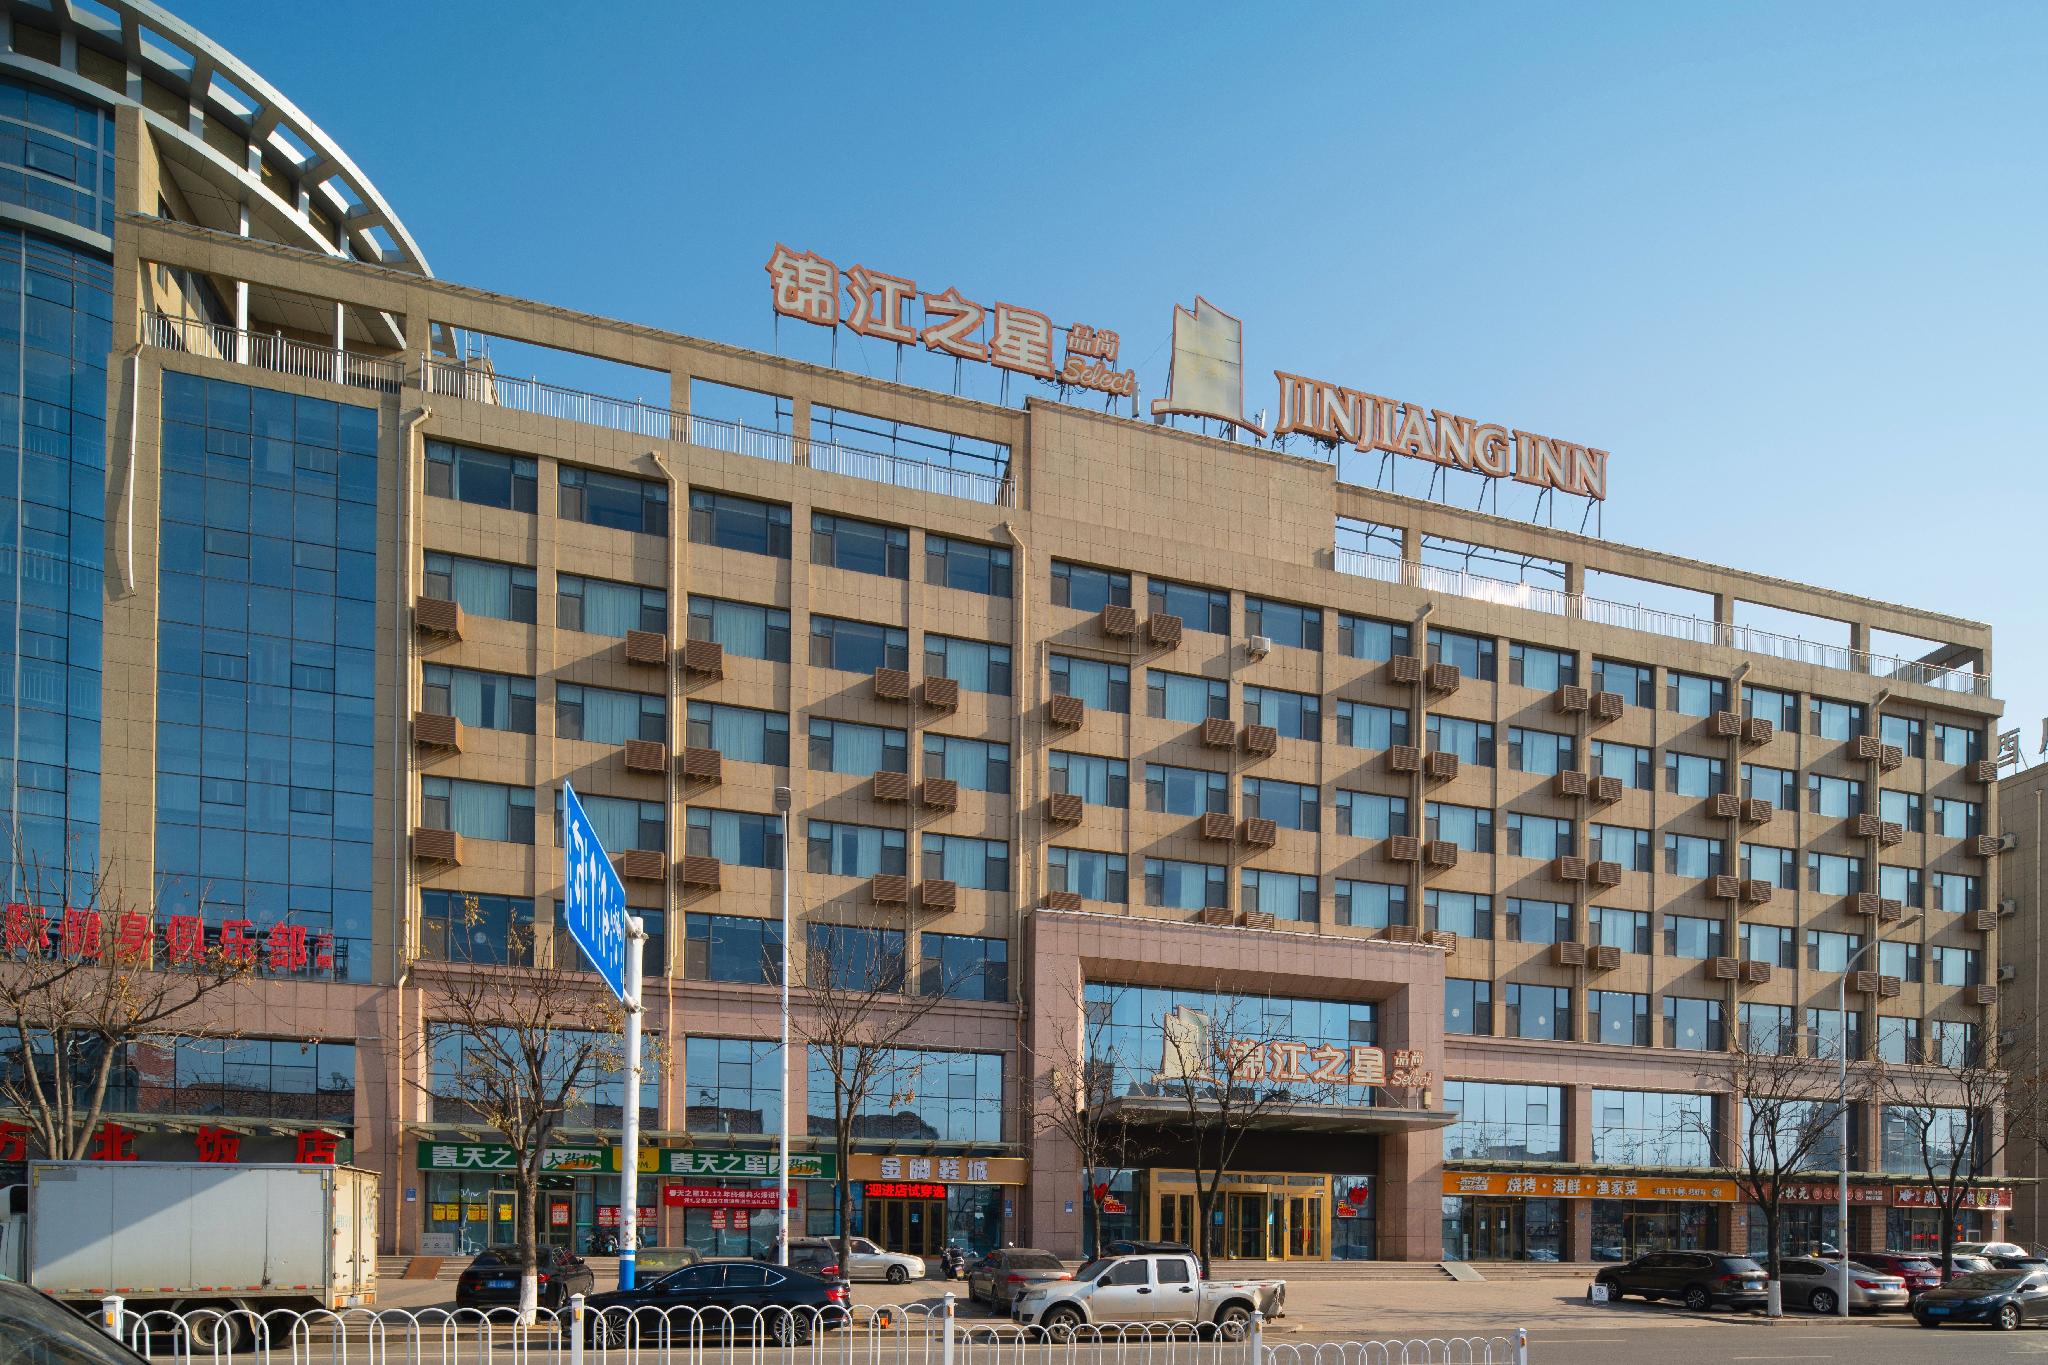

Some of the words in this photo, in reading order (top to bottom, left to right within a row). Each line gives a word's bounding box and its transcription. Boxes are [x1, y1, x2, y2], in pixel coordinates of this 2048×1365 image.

[765, 242, 1055, 380] 锦江之星
[1067, 323, 1120, 361] 品尚
[1062, 357, 1135, 397] Select
[1273, 370, 1511, 479] JINJIANG
[1513, 429, 1610, 501] INN
[1226, 1038, 1386, 1087] 锦江之星
[1390, 1068, 1433, 1088] Select
[670, 1153, 767, 1175] 春天之星
[865, 1183, 946, 1198] 迎进店试穿选
[1774, 1186, 1810, 1201] 状元
